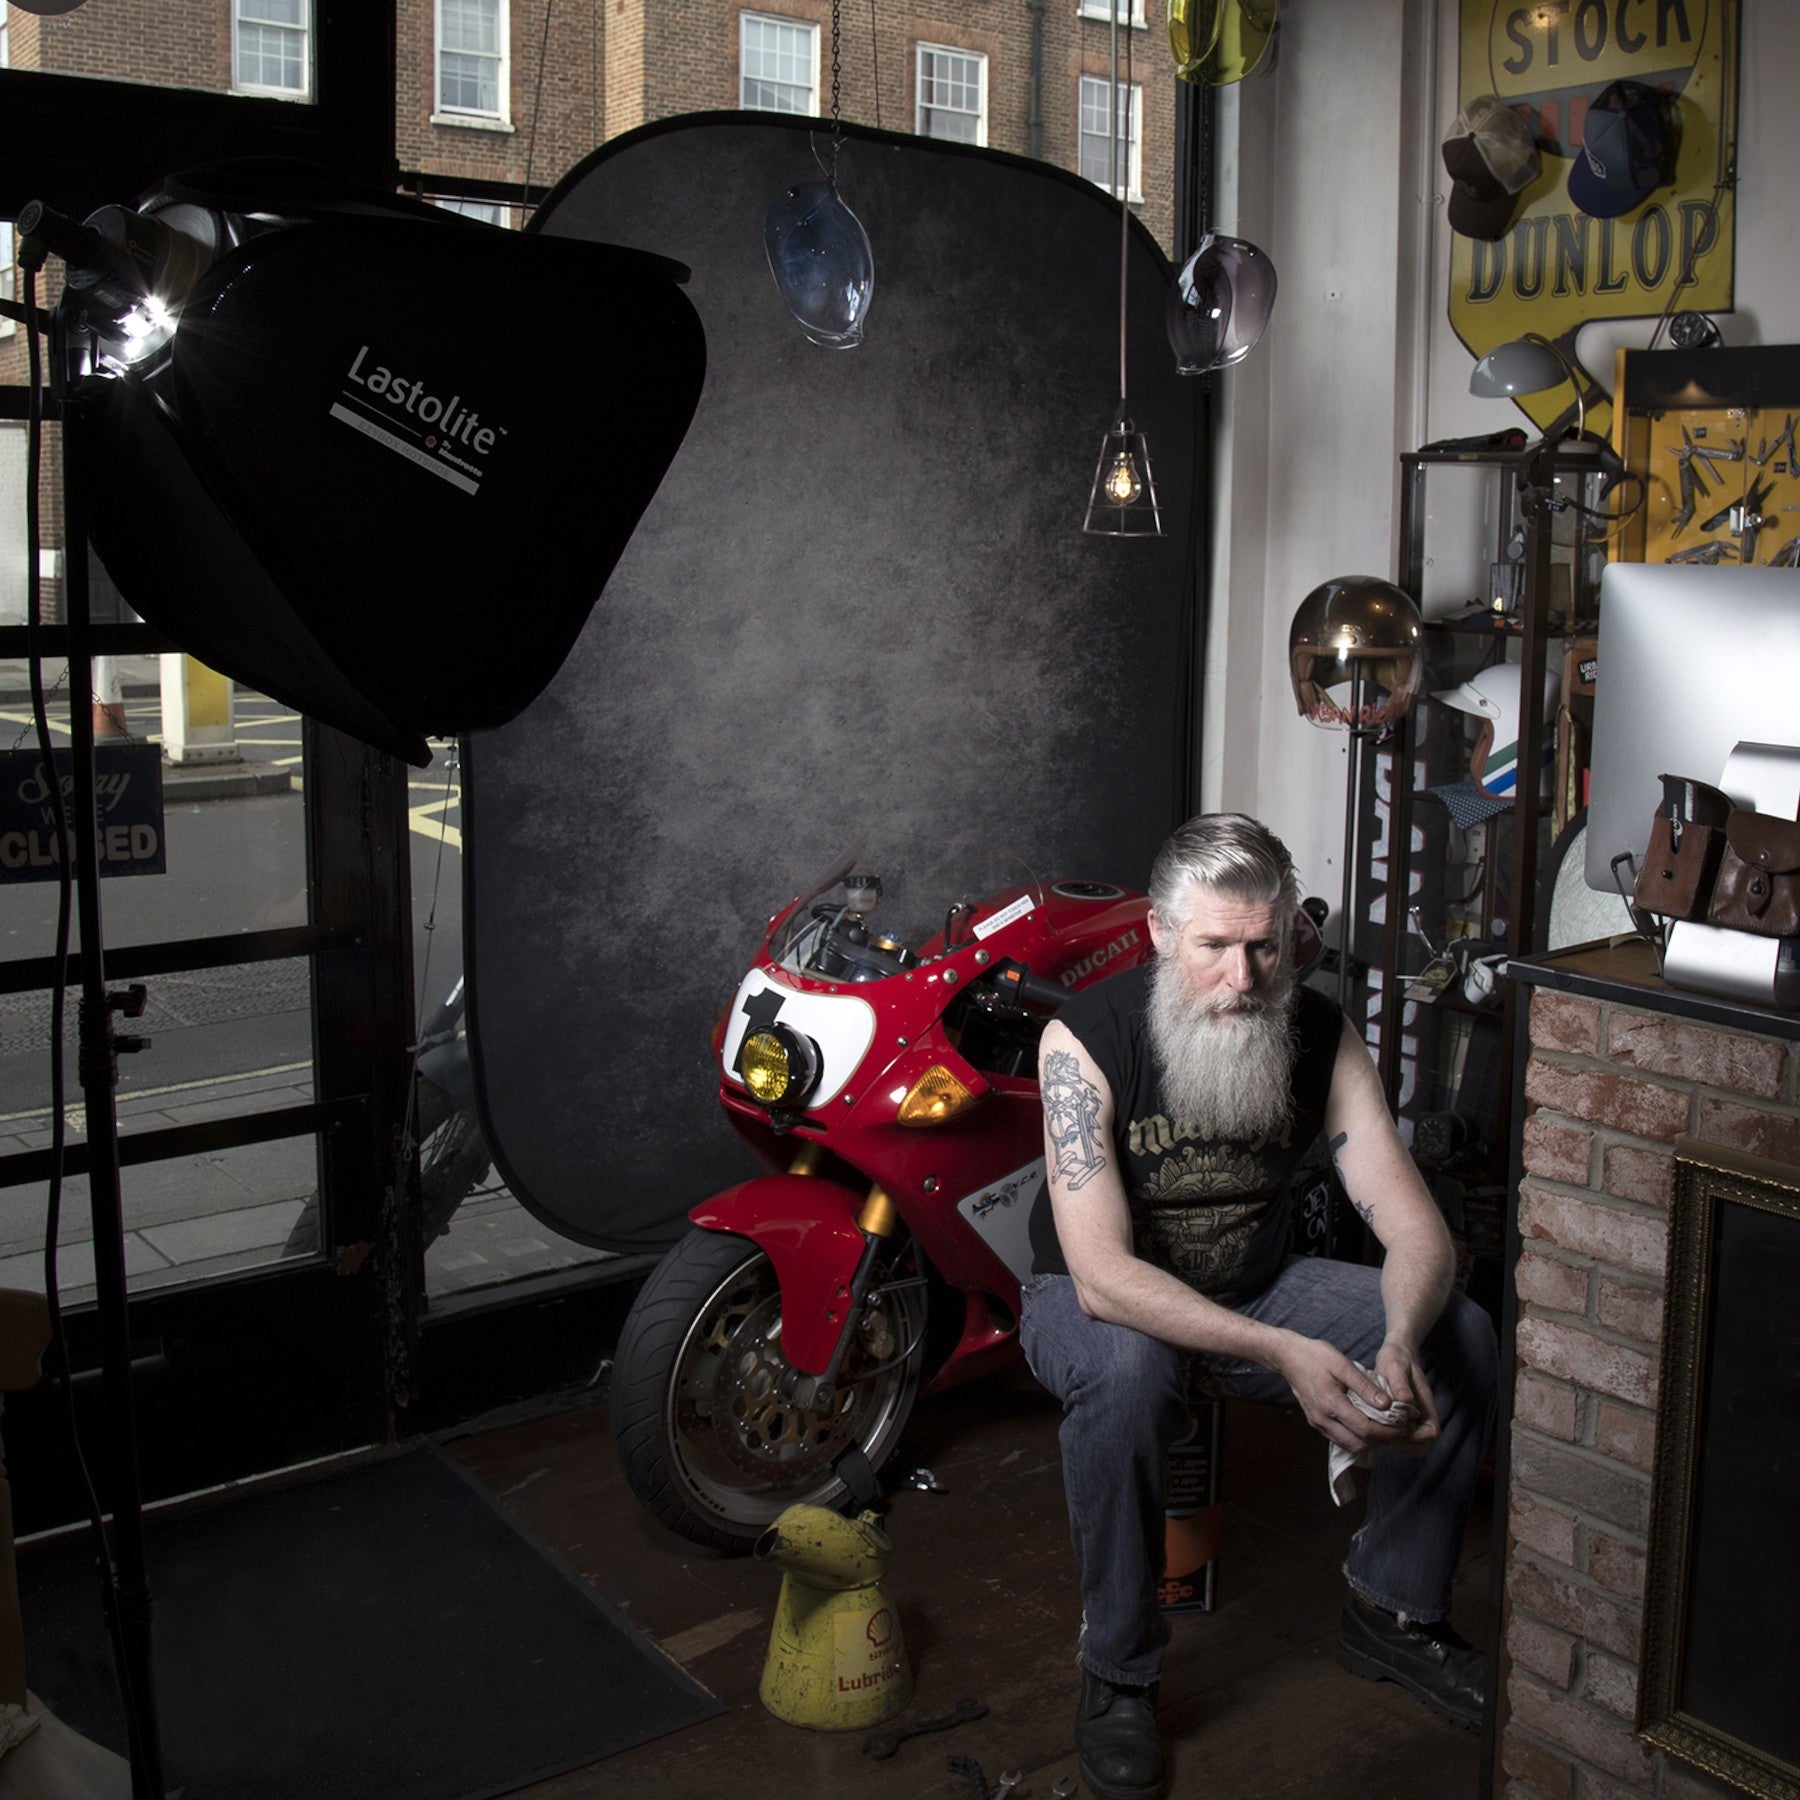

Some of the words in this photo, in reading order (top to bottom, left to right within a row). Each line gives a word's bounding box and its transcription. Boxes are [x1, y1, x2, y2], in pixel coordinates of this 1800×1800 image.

[1503, 0, 1692, 75] STOCK
[1466, 200, 1720, 303] DUNLOP
[18, 762, 131, 812] Sory
[1060, 928, 1140, 988] DUCATI
